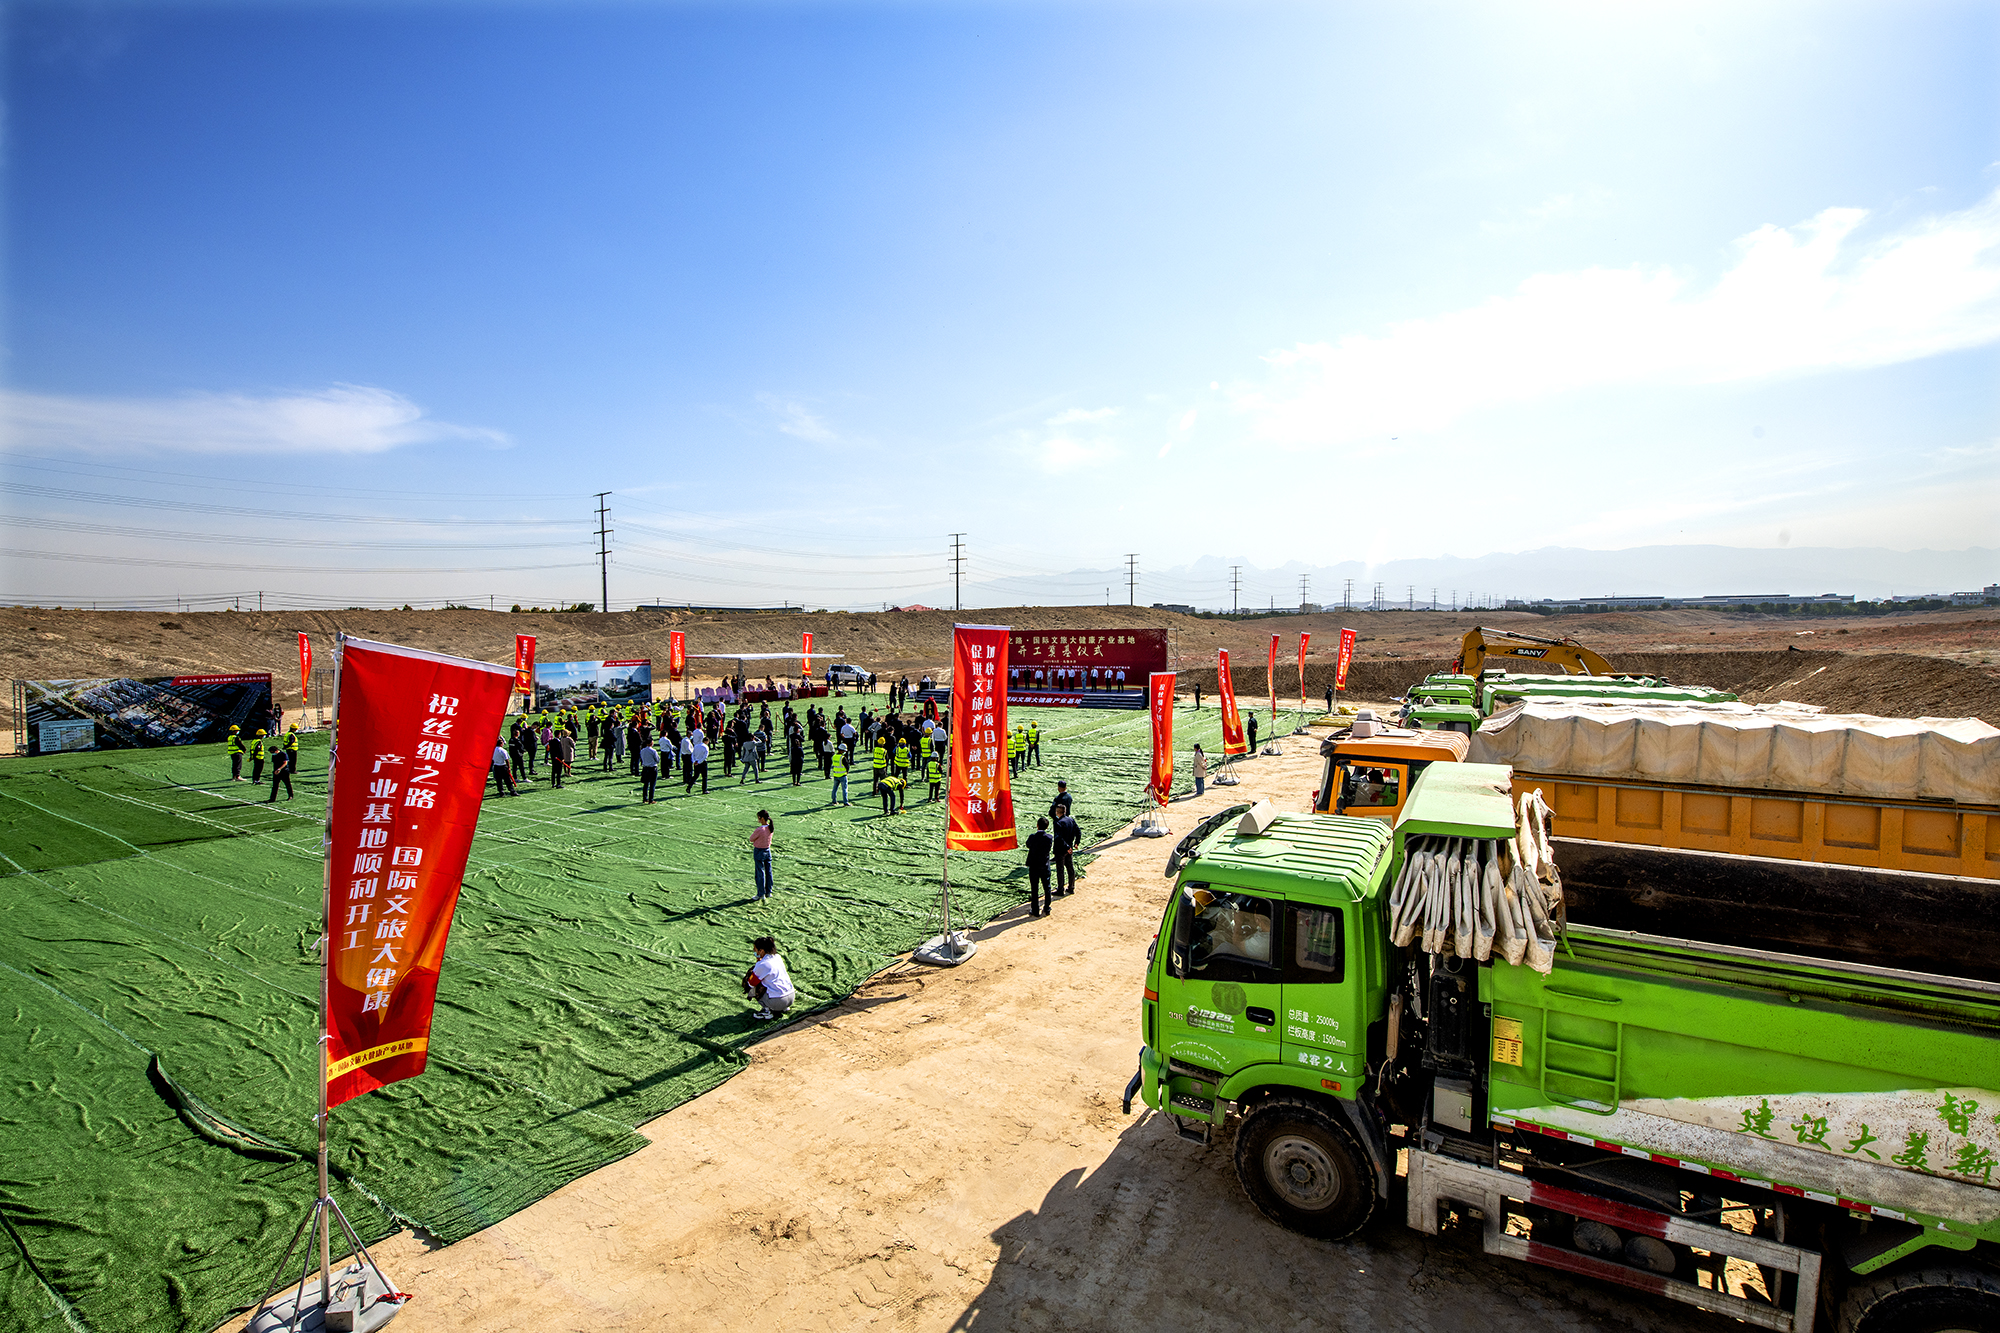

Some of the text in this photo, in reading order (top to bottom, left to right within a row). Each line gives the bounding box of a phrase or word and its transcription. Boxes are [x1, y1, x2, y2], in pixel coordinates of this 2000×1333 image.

[1517, 648, 1543, 656] SANY
[967, 644, 984, 815] 促进文旅产业融合发展
[340, 753, 405, 951] 产业基地顺利开工
[1316, 1014, 1339, 1031] 25000kg
[1322, 1033, 1347, 1048] 1500mm
